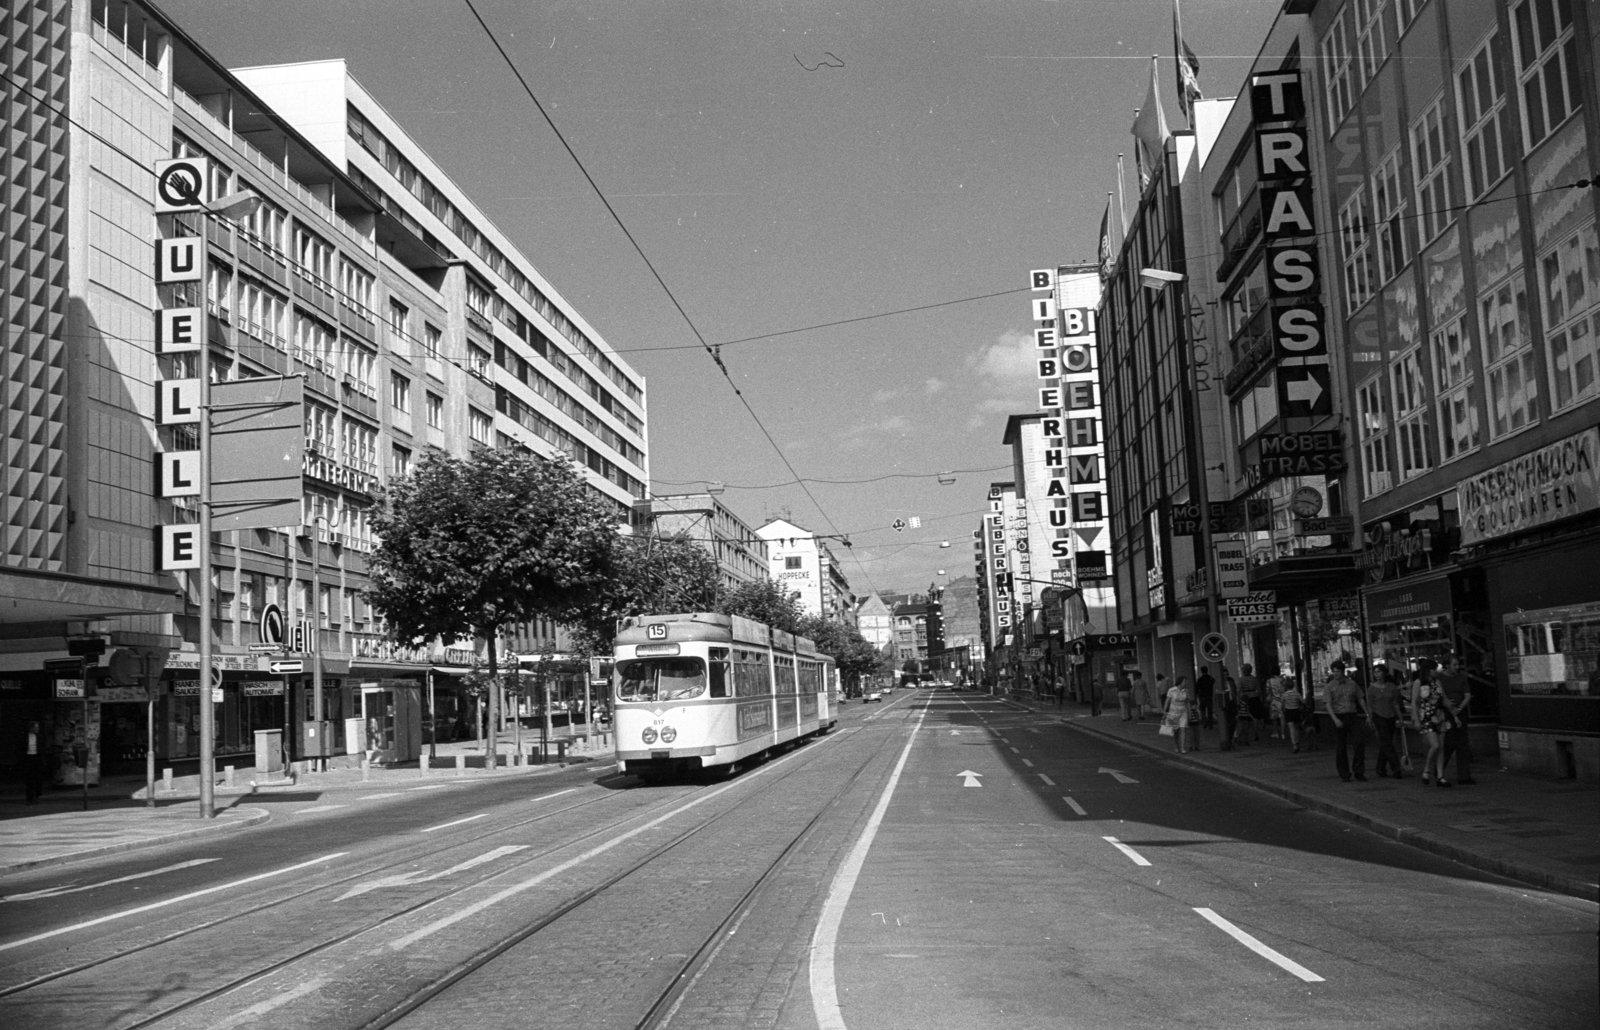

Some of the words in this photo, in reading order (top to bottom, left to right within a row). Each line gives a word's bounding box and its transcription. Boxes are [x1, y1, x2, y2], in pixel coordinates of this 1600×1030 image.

[1252, 74, 1320, 352] TRASS
[158, 161, 203, 561] QUELLE
[1033, 270, 1070, 558] BIEBERHAUS
[1062, 308, 1099, 520] BOEHME
[1261, 433, 1342, 454] MÖBEL
[1263, 453, 1342, 475] TRASS
[1465, 438, 1592, 511] INTERSCHMUCK
[1478, 485, 1577, 533] GOLDWAREN
[1302, 520, 1326, 531] Bad
[991, 487, 1009, 627] BIEBERAUS
[1053, 570, 1071, 579] noch
[1220, 562, 1245, 572] TRASS
[779, 571, 810, 581] HOPPECKE
[1078, 572, 1106, 580] WOHNEN
[1231, 604, 1274, 615] TRASS
[651, 625, 664, 636] 15
[1, 679, 22, 689] QUELLE
[175, 688, 201, 696] SAUGE
